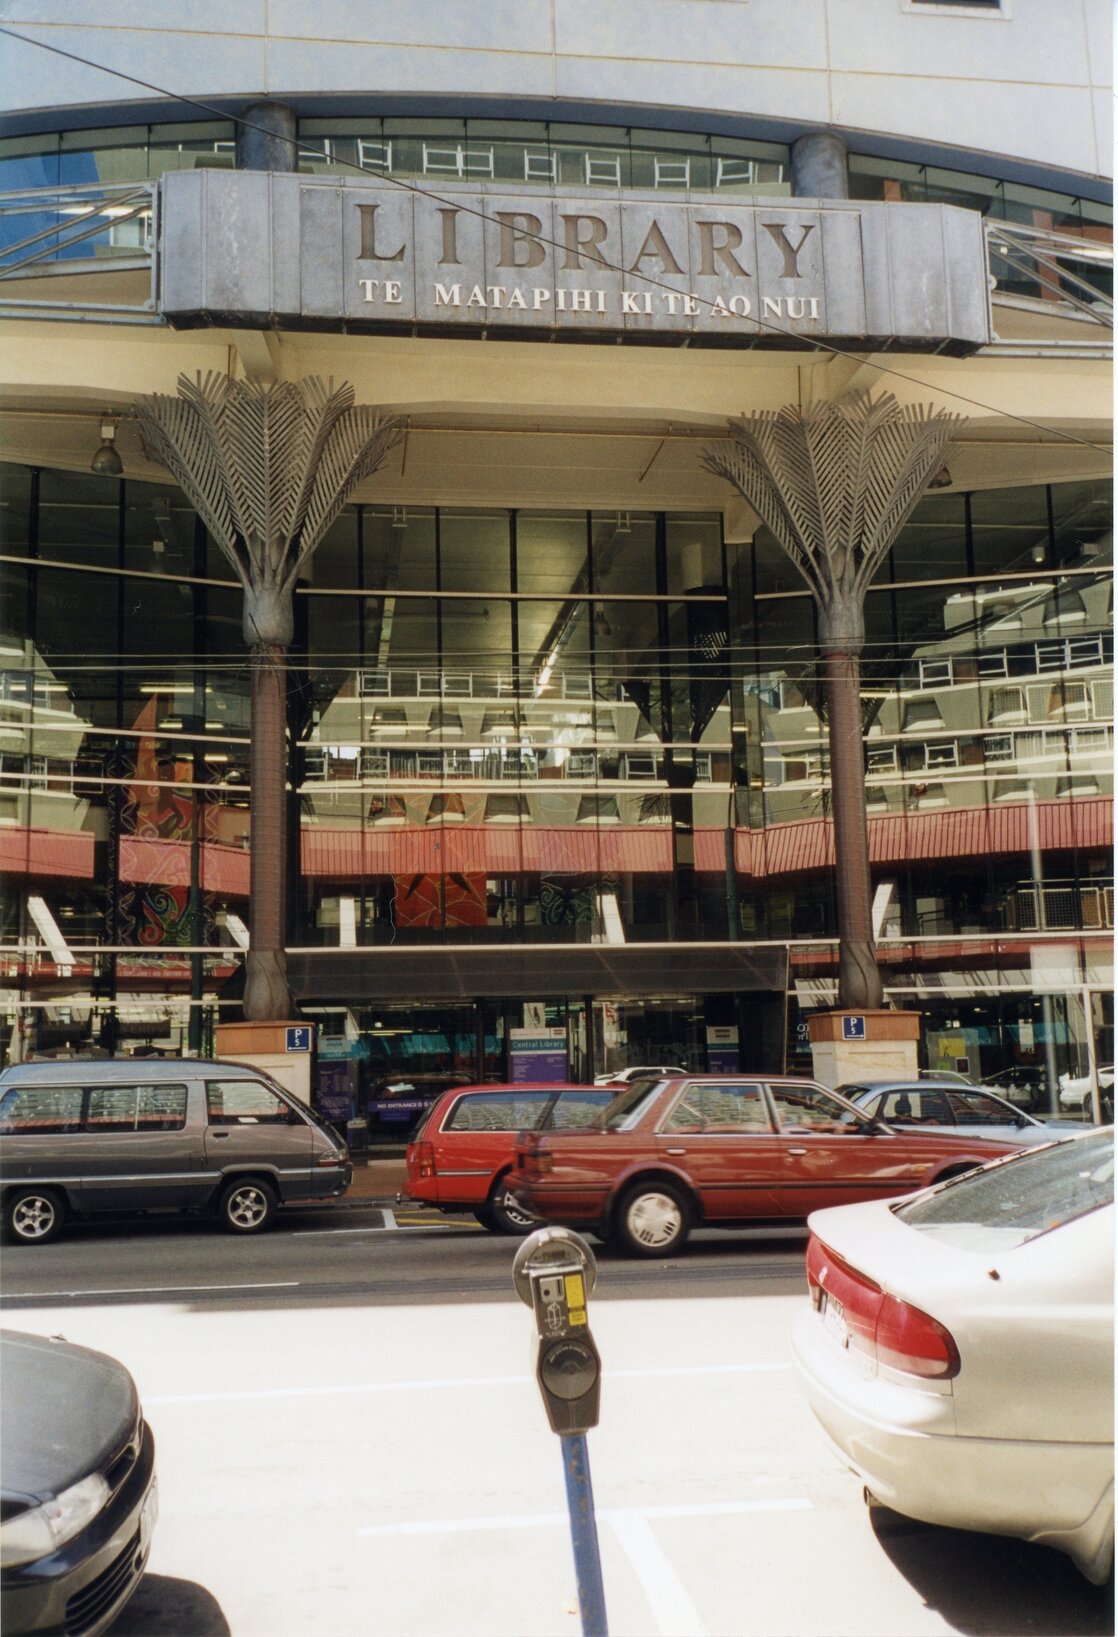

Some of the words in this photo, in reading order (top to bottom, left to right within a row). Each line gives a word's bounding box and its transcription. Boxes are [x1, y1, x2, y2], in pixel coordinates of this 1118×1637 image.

[356, 204, 814, 278] LIBRARY
[359, 280, 403, 303] TE
[433, 283, 607, 313] MATAPIHI
[621, 291, 654, 314] KI
[662, 293, 701, 316] TE
[709, 295, 751, 317] AO
[761, 296, 820, 320] NUI
[850, 1018, 857, 1026] P
[295, 1029, 302, 1038] P
[513, 1041, 537, 1049] Central
[540, 1040, 564, 1048] Library
